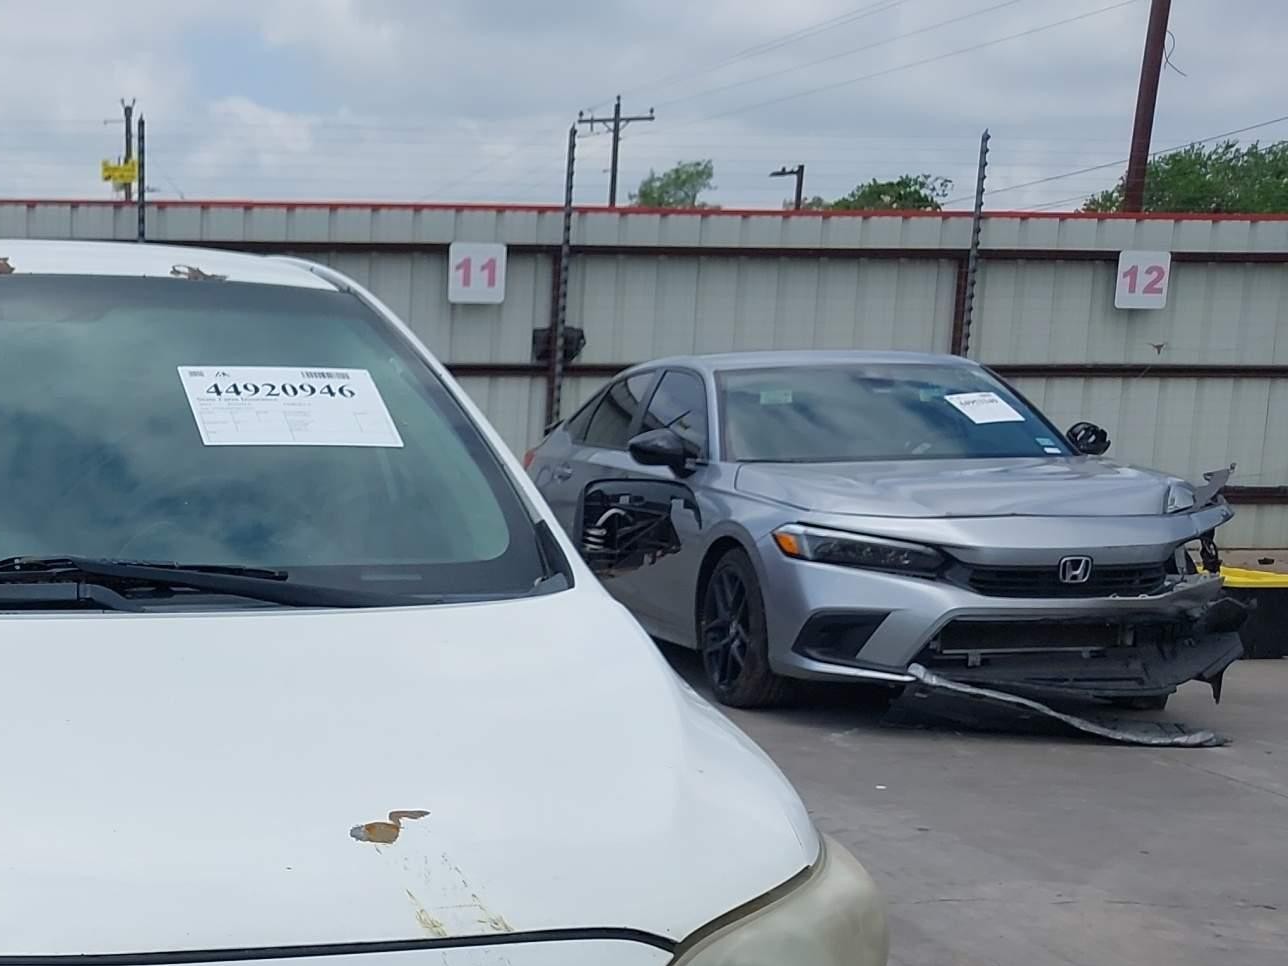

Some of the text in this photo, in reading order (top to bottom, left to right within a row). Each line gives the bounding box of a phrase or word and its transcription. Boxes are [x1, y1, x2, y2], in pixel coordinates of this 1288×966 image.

[454, 256, 497, 289] 11
[1122, 264, 1165, 295] 12
[205, 381, 357, 399] 44920946
